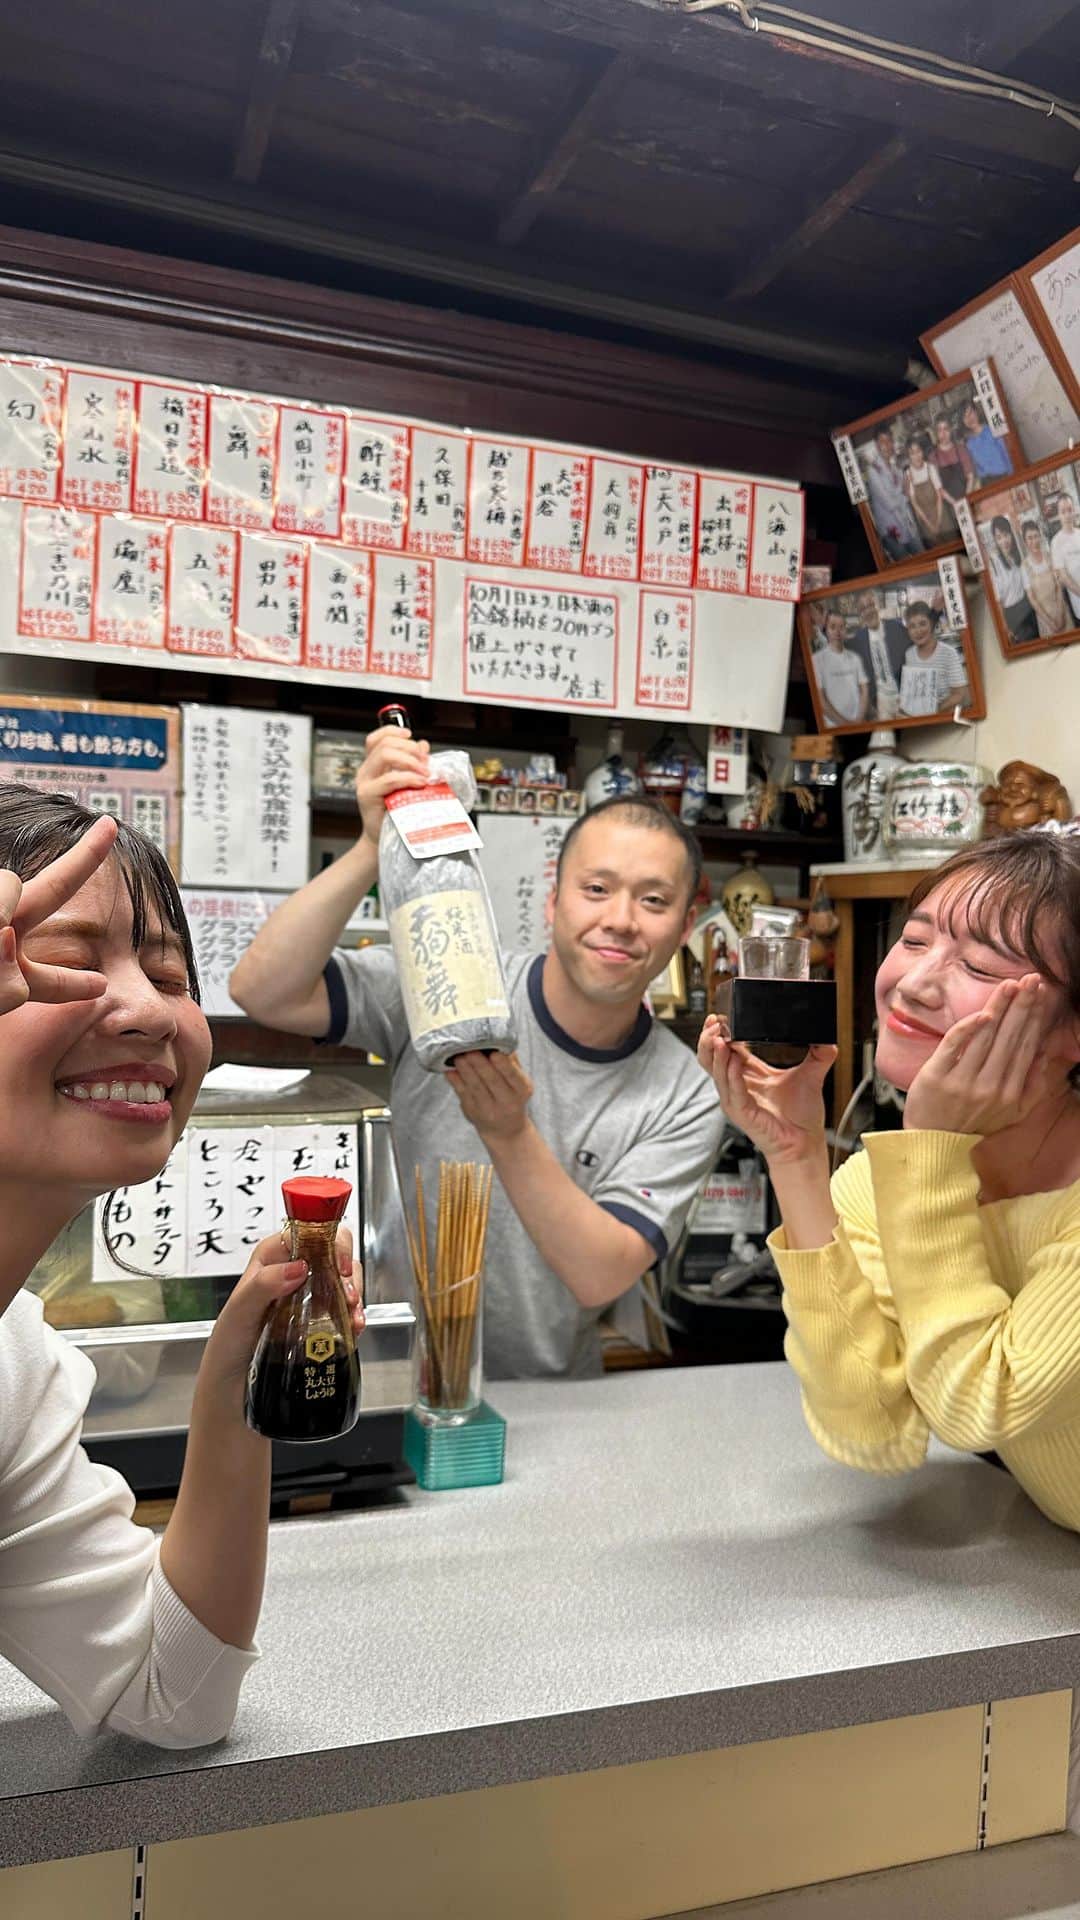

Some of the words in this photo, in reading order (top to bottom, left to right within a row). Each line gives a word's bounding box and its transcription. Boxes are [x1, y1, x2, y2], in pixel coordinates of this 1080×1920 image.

[7, 399, 35, 420] 幻
[432, 447, 456, 506] 久保田
[486, 449, 512, 525] 越乃寒梅
[602, 478, 622, 540] 天狗舞
[767, 501, 790, 556] 八海山
[256, 559, 279, 609] 男山
[650, 609, 672, 659] 白糸
[409, 904, 460, 1018] 天狗舞
[196, 1139, 231, 1257] ところ天
[305, 1375, 336, 1389] 丸大豆
[305, 1387, 336, 1400] しょうゆ
